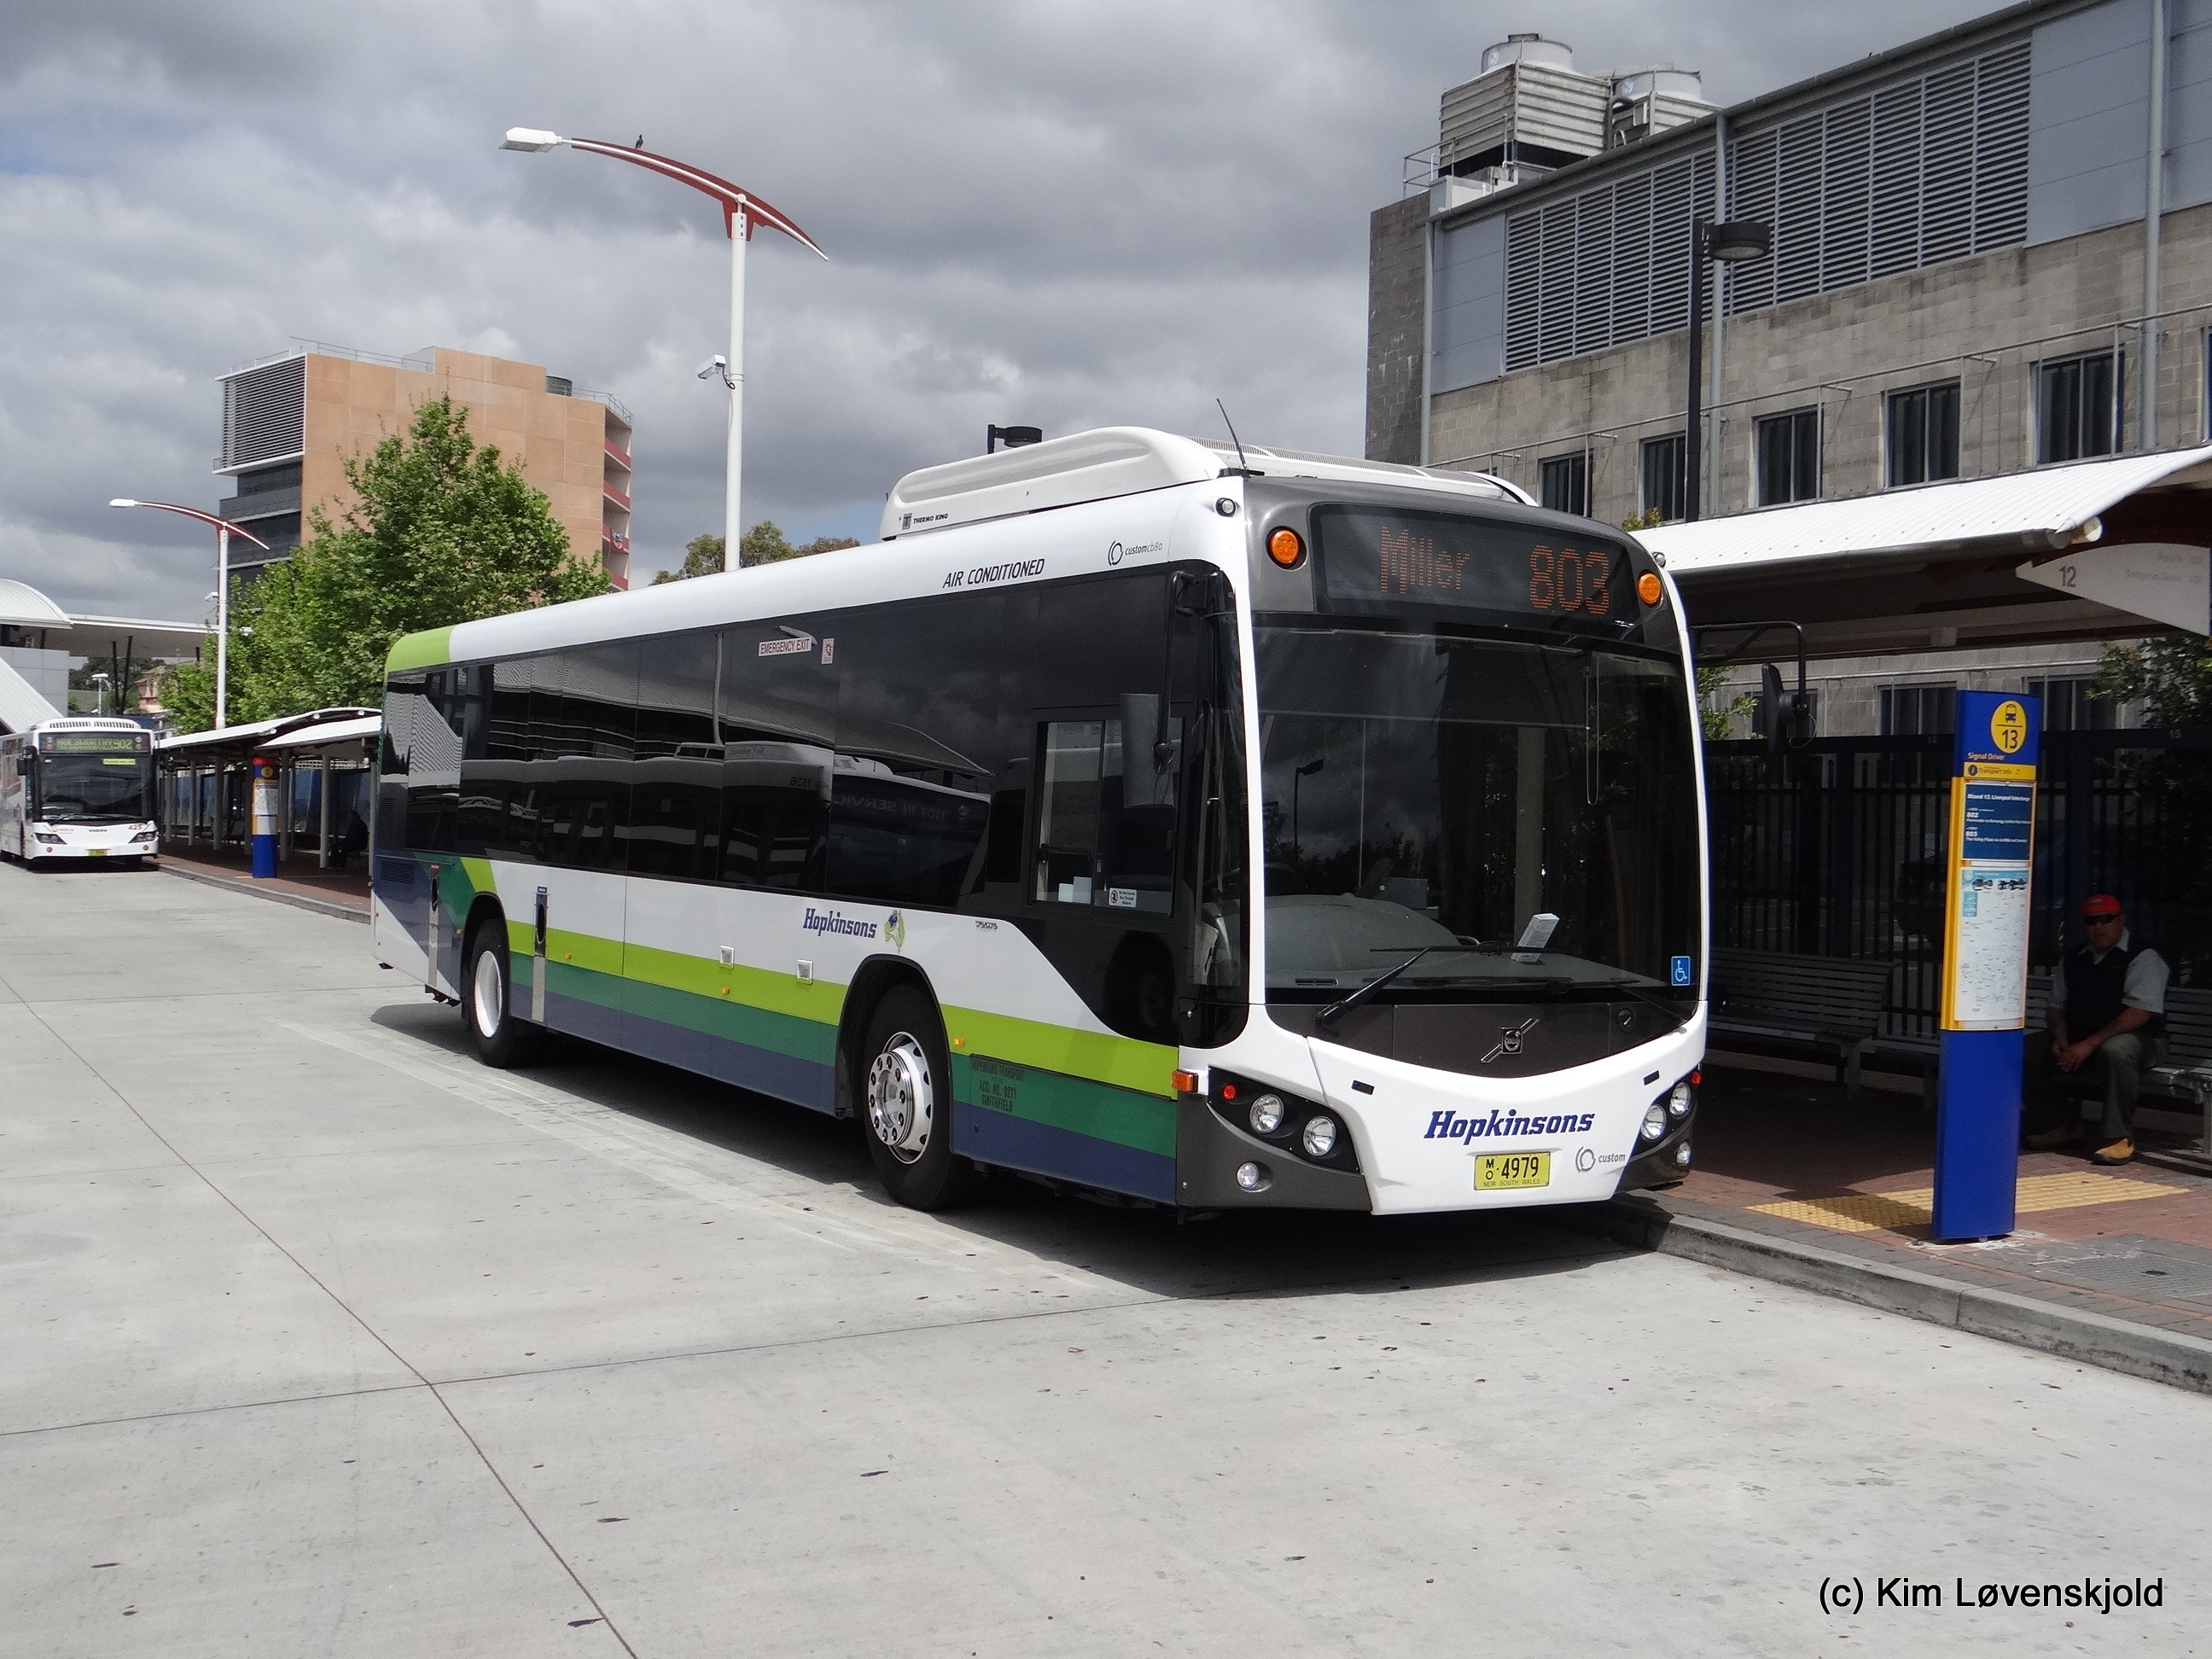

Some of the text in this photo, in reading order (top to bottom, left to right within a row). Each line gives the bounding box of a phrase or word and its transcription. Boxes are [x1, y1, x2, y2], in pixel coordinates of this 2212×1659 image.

[913, 515, 934, 524] THERMO
[942, 557, 1045, 588] AIR CONDITIONED
[1380, 526, 1610, 615] Miller 803
[2058, 565, 2076, 588] 12
[760, 638, 811, 655] EMERGENCY EXIT
[113, 738, 132, 749] 902
[2002, 729, 2018, 749] 13
[802, 907, 878, 940] Hopkinsons
[981, 1093, 1013, 1113] SMITHFIELD
[1423, 1109, 1595, 1145] Hopkinsons
[1501, 1156, 1539, 1179] 4979
[1598, 1153, 1626, 1163] custom
